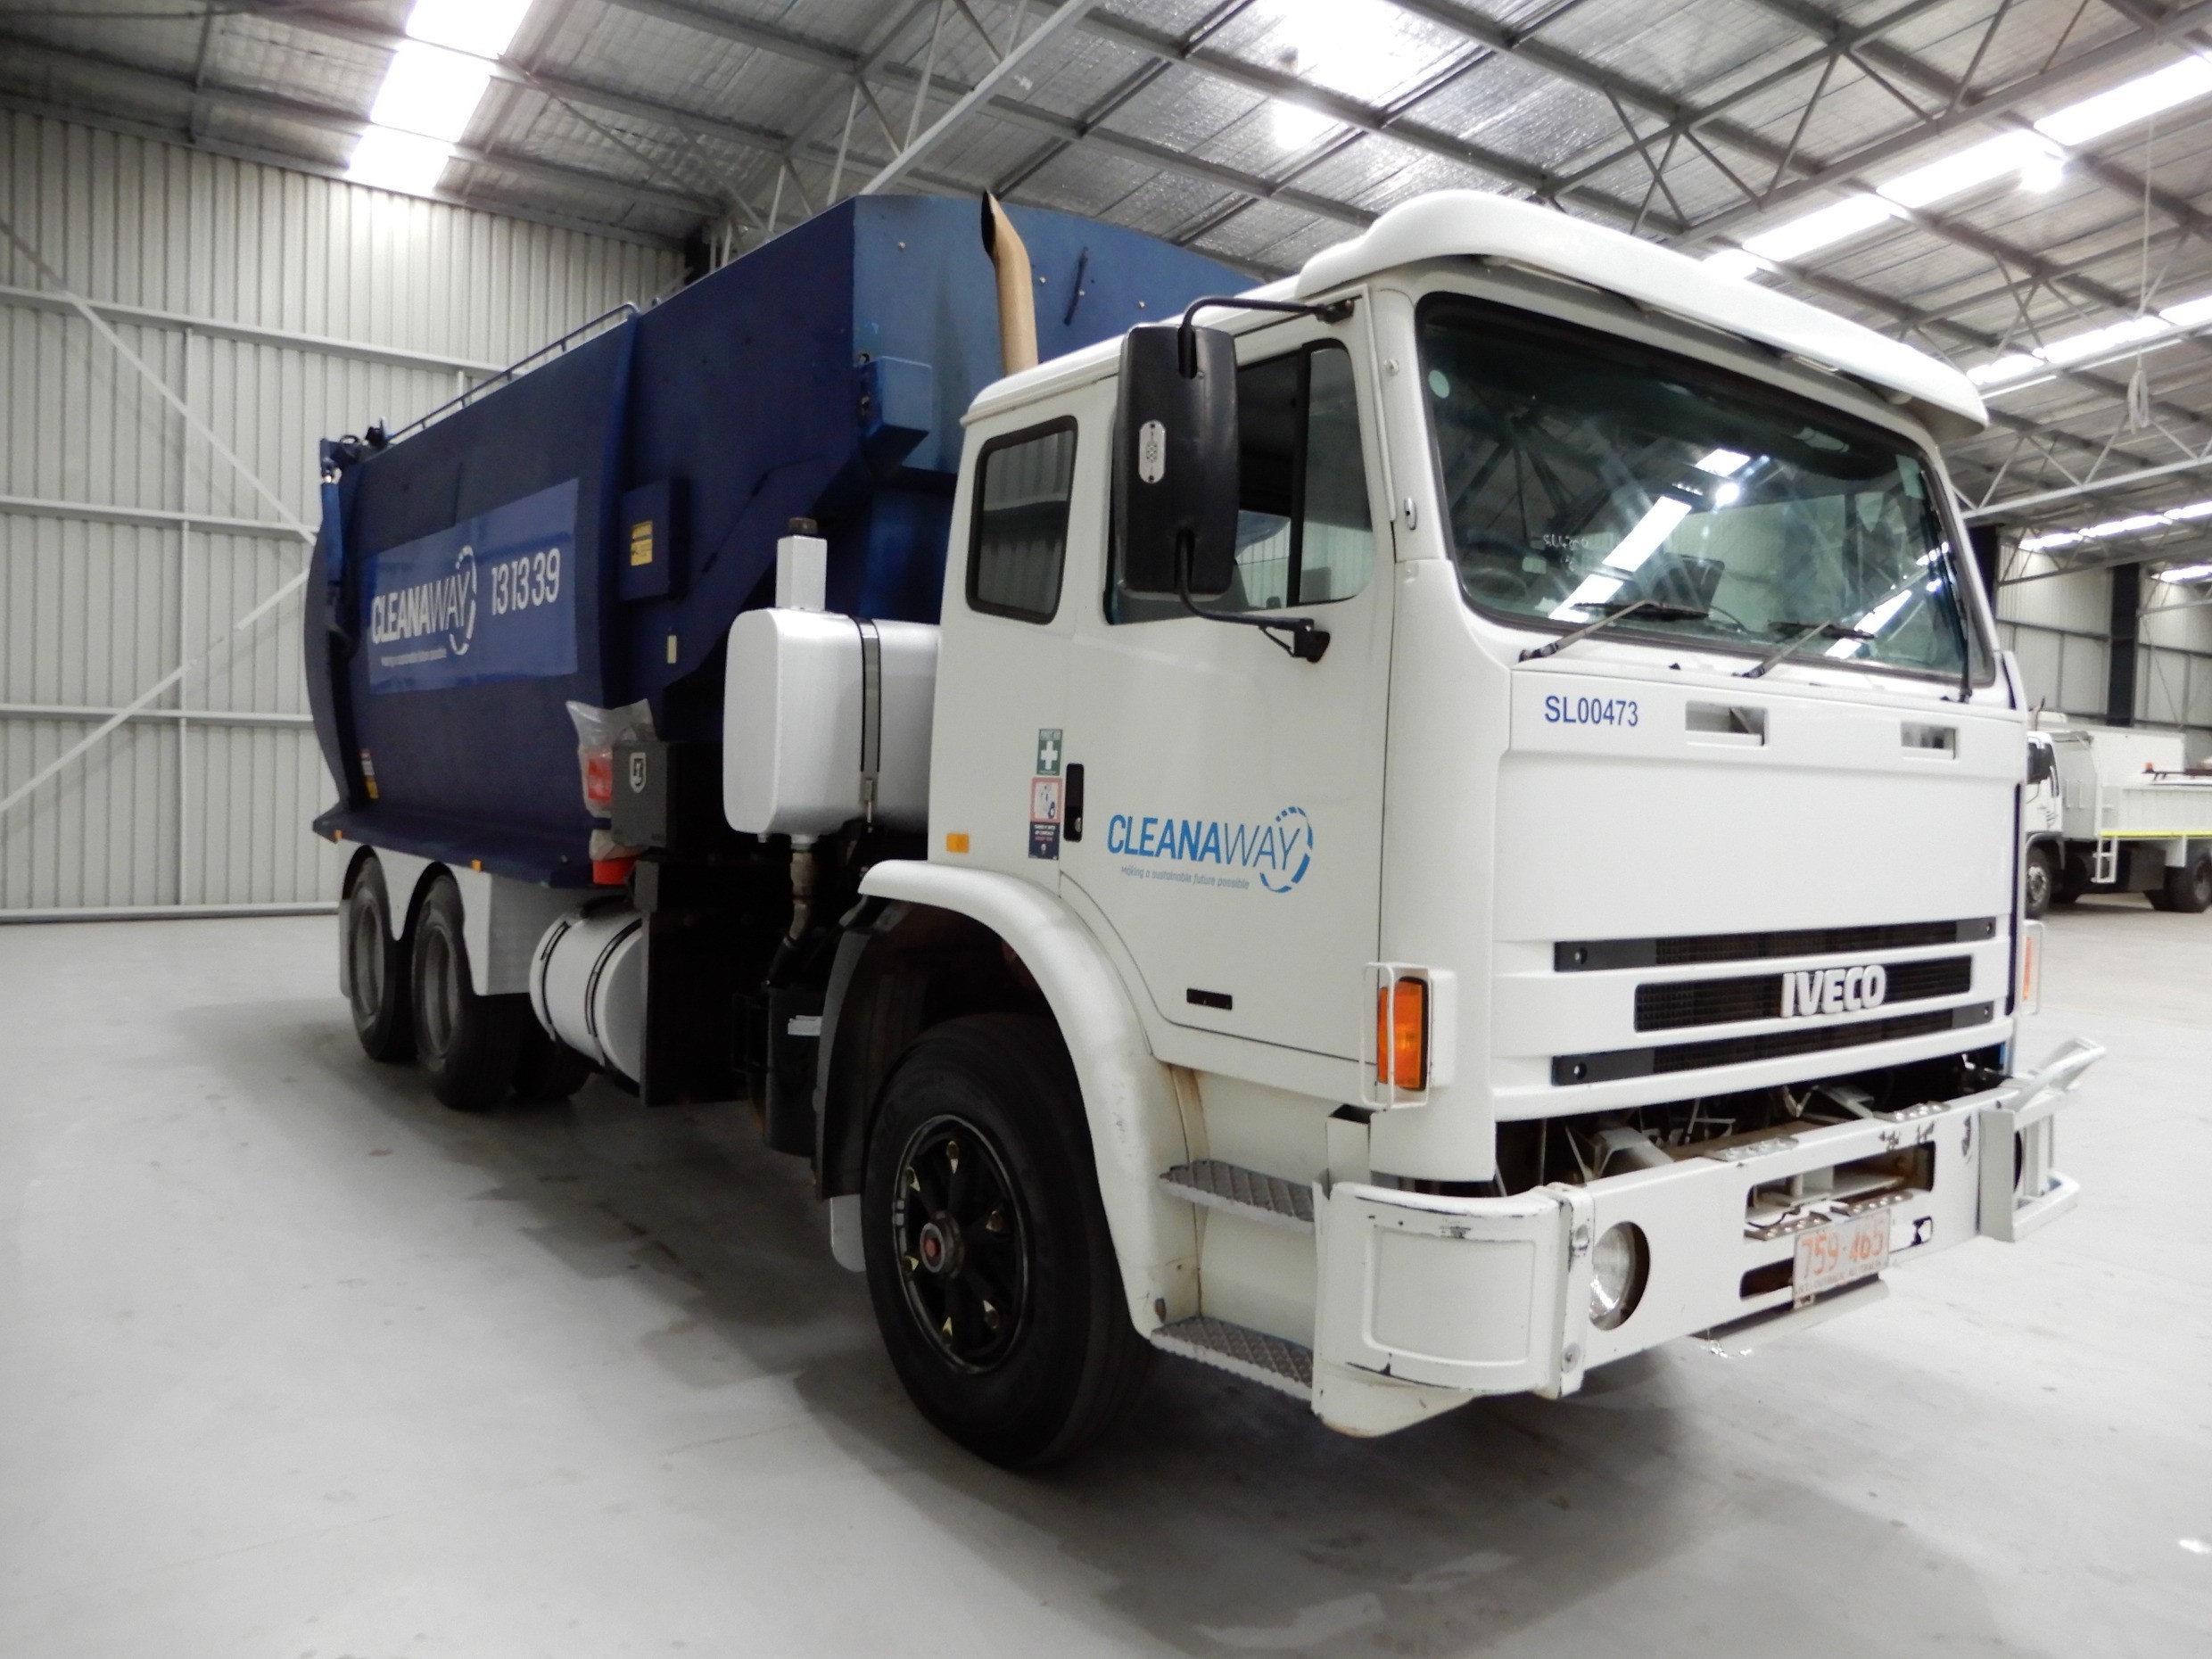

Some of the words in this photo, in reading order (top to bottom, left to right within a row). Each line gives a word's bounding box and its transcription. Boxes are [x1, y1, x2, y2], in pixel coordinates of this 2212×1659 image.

[371, 571, 471, 645] CLEANAWAY
[1544, 695, 1638, 727] SL00473
[1107, 813, 1301, 871] CLEANAWAY
[1120, 864, 1144, 879] Making
[1779, 964, 1886, 1018] IVECO
